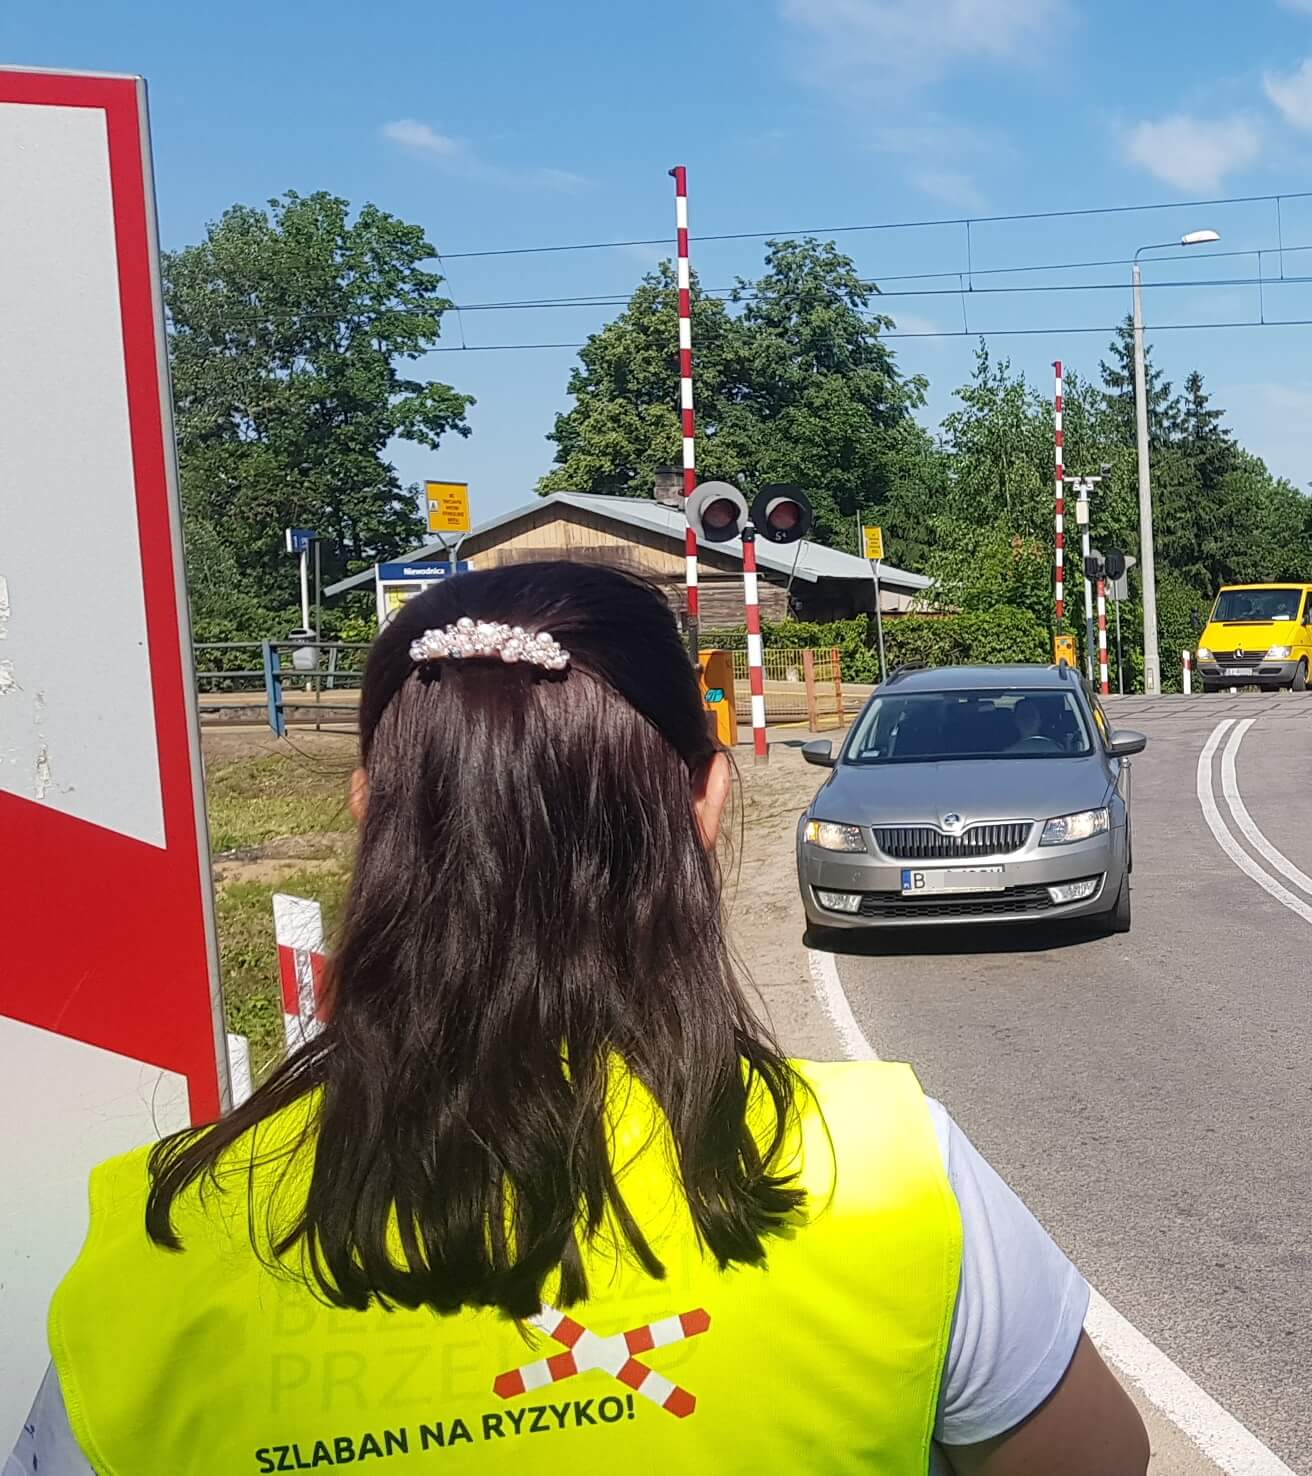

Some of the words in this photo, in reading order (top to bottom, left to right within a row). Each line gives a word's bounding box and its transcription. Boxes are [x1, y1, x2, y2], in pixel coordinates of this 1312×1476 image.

[403, 567, 445, 575] Niewodnica
[255, 1428, 408, 1473] SZLABAN
[419, 1417, 473, 1451] NA
[482, 1394, 635, 1441] RYZYKO!
